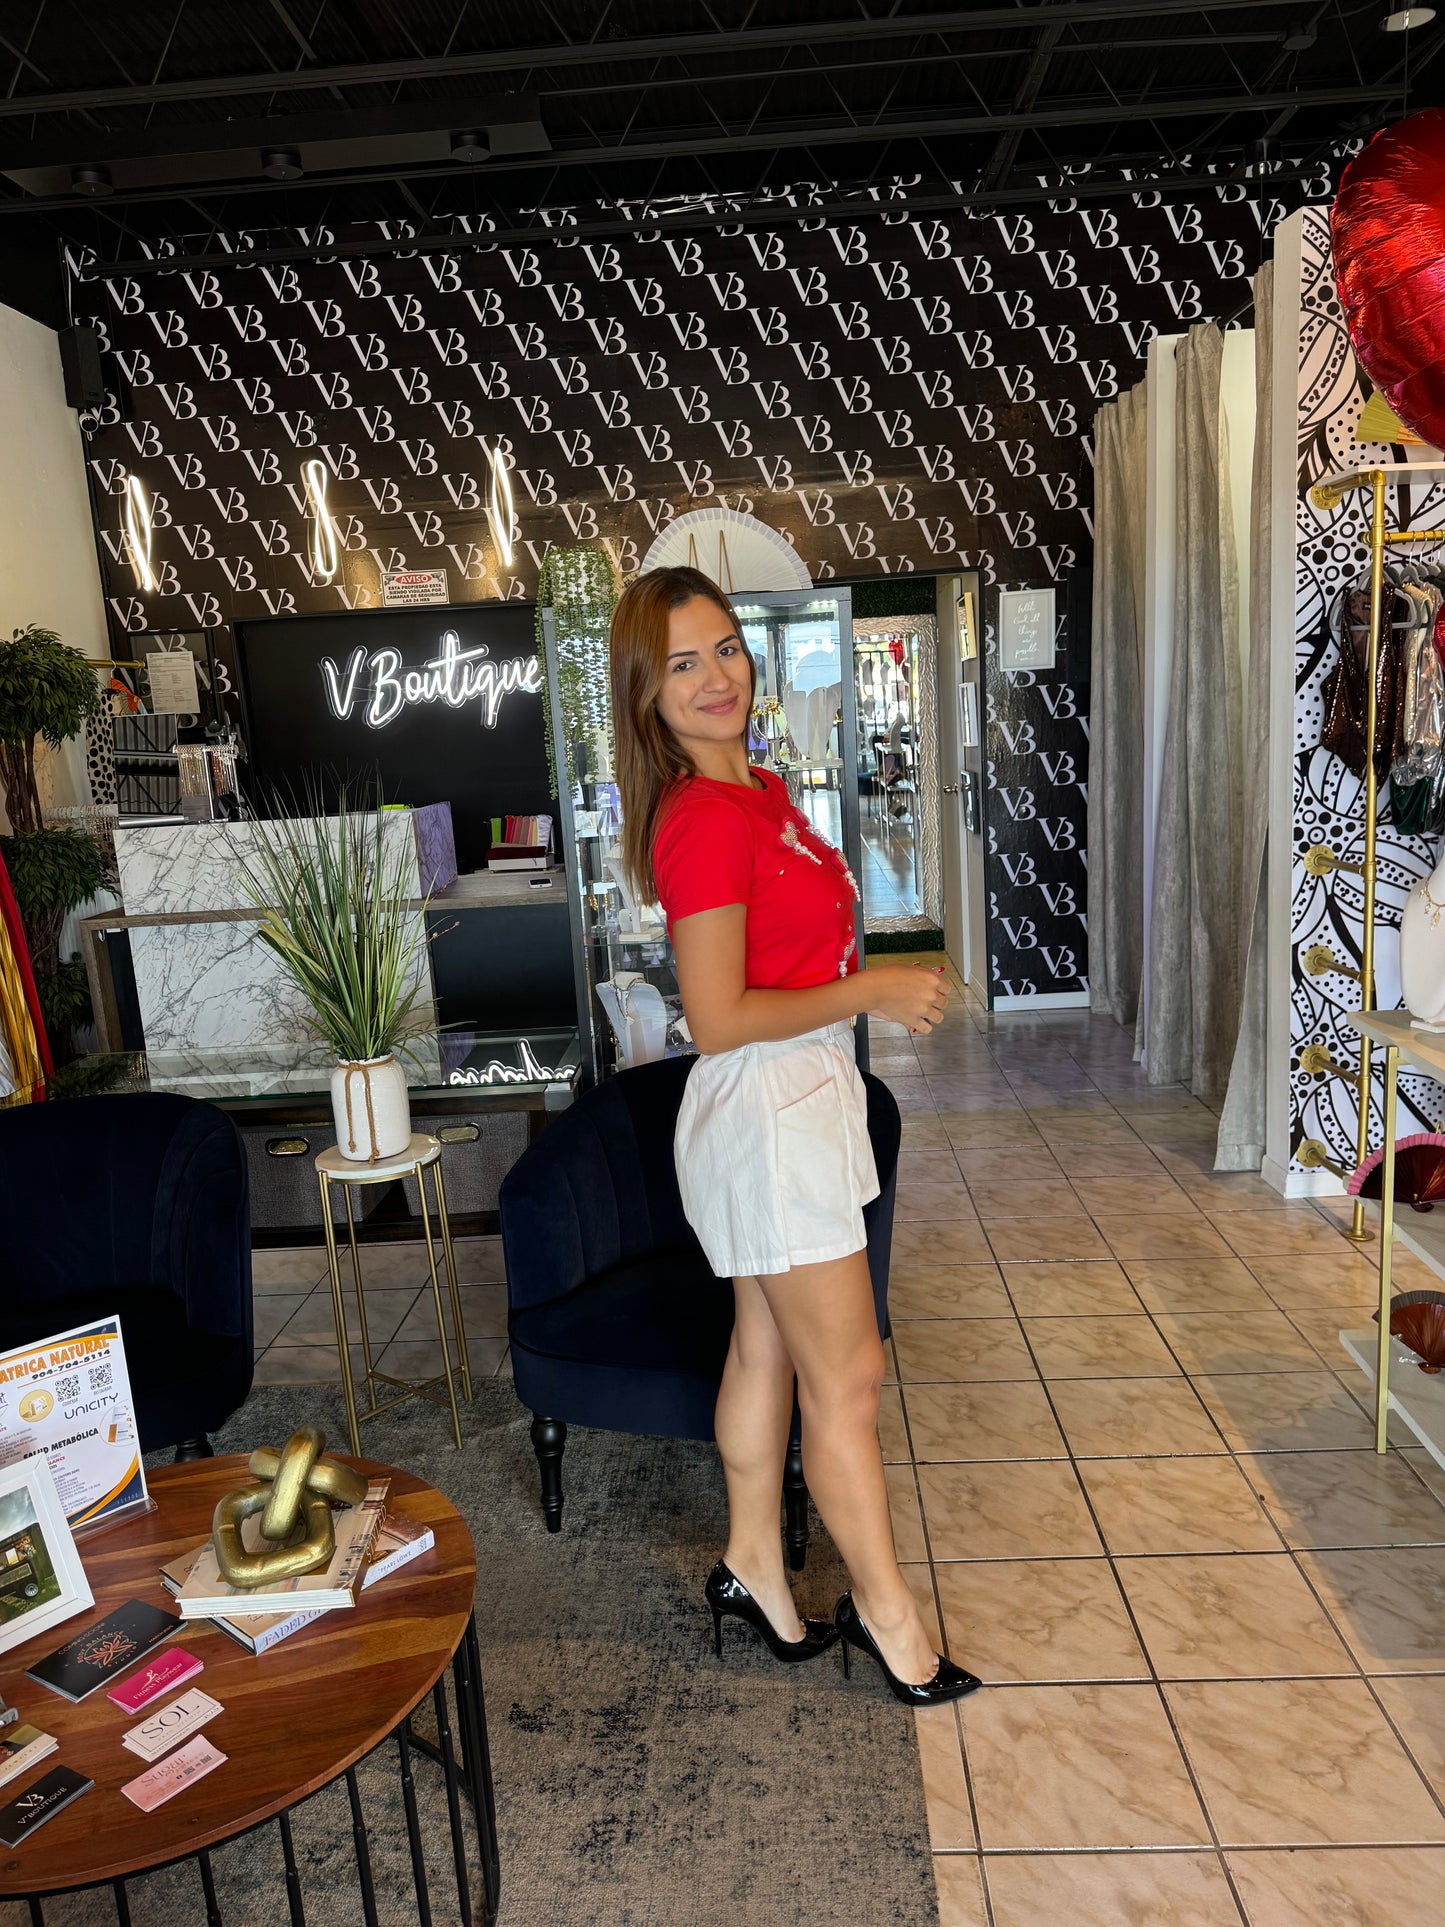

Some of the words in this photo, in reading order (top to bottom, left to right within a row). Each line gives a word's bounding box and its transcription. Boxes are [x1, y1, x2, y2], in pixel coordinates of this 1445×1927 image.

[907, 221, 952, 260] VB
[992, 215, 1035, 254] VB
[1076, 210, 1119, 249] VB
[1159, 205, 1204, 244] VB
[580, 244, 623, 283] VB
[661, 238, 704, 277] VB
[743, 233, 786, 272] VB
[824, 227, 869, 266] VB
[1118, 245, 1161, 284] VB
[1202, 240, 1245, 279] VB
[338, 260, 381, 299] VB
[419, 255, 462, 294] VB
[499, 249, 542, 288] VB
[784, 267, 829, 306] VB
[868, 262, 911, 301] VB
[949, 256, 994, 295] VB
[1033, 250, 1078, 289] VB
[462, 288, 505, 327] VB
[542, 283, 585, 322] VB
[622, 278, 665, 317] VB
[704, 272, 747, 311] VB
[991, 290, 1036, 329] VB
[1076, 285, 1119, 324] VB
[1158, 280, 1203, 319] VB
[146, 311, 187, 348] VB
[224, 305, 265, 344] VB
[302, 299, 345, 338] VB
[382, 294, 425, 333] VB
[665, 312, 708, 351] VB
[746, 307, 789, 346] VB
[828, 302, 871, 341] VB
[910, 296, 953, 335] VB
[346, 333, 387, 372] VB
[425, 328, 468, 367] VB
[505, 323, 546, 362] VB
[584, 317, 627, 356] VB
[868, 336, 913, 375] VB
[950, 330, 995, 369] VB
[1033, 325, 1078, 364] VB
[112, 350, 153, 387] VB
[189, 344, 230, 381] VB
[267, 339, 310, 376] VB
[546, 356, 589, 395] VB
[626, 351, 669, 390] VB
[707, 346, 750, 385] VB
[788, 342, 831, 381] VB
[232, 378, 273, 415] VB
[311, 373, 352, 410] VB
[390, 368, 431, 405] VB
[467, 361, 510, 400] VB
[830, 376, 873, 415] VB
[911, 370, 954, 409] VB
[993, 365, 1036, 404] VB
[1076, 360, 1119, 399] VB
[155, 383, 196, 420] VB
[432, 401, 473, 438] VB
[510, 395, 551, 434] VB
[588, 390, 631, 429] VB
[669, 386, 710, 425] VB
[749, 381, 792, 420] VB
[1035, 399, 1078, 438] VB
[198, 416, 239, 453] VB
[275, 411, 316, 448] VB
[353, 406, 394, 443] VB
[711, 420, 752, 459] VB
[790, 415, 833, 454] VB
[871, 410, 914, 447] VB
[952, 404, 995, 443] VB
[396, 439, 437, 476] VB
[552, 429, 593, 468] VB
[630, 424, 673, 463] VB
[994, 440, 1037, 477] VB
[164, 453, 205, 490] VB
[241, 449, 282, 486] VB
[672, 460, 715, 497] VB
[753, 456, 794, 493] VB
[832, 450, 875, 489] VB
[912, 445, 955, 482] VB
[361, 478, 402, 515] VB
[439, 473, 480, 510] VB
[516, 469, 557, 506] VB
[594, 465, 635, 502] VB
[873, 484, 916, 521] VB
[953, 478, 996, 515] VB
[1035, 473, 1078, 510] VB
[207, 487, 248, 524] VB
[558, 503, 599, 540] VB
[793, 489, 836, 526] VB
[173, 525, 214, 560] VB
[249, 519, 290, 556] VB
[403, 511, 444, 548] VB
[835, 523, 876, 560] VB
[914, 517, 957, 554] VB
[995, 512, 1036, 549] VB
[215, 557, 256, 592] VB
[400, 575, 429, 584] AVISO
[445, 543, 486, 580] VB
[181, 593, 222, 628] VB
[321, 645, 367, 720] V
[366, 629, 546, 729] Boutique
[1035, 684, 1076, 719] VB
[995, 720, 1036, 755] VB
[1035, 751, 1076, 786] VB
[995, 786, 1036, 821] VB
[1035, 817, 1076, 852] VB
[996, 852, 1037, 887] VB
[1035, 882, 1076, 917] VB
[998, 916, 1037, 951] VB
[1036, 945, 1077, 980] VB
[32, 1349, 111, 1380] 904-704-5114
[49, 1335, 110, 1366] NATURAL
[64, 1393, 119, 1420] UNICITY
[51, 1427, 99, 1451] METABÓLICA
[264, 1614, 306, 1646] FADED
[133, 1682, 157, 1700] Fitness
[156, 1662, 183, 1685] Playwear
[141, 1704, 200, 1740] SOL
